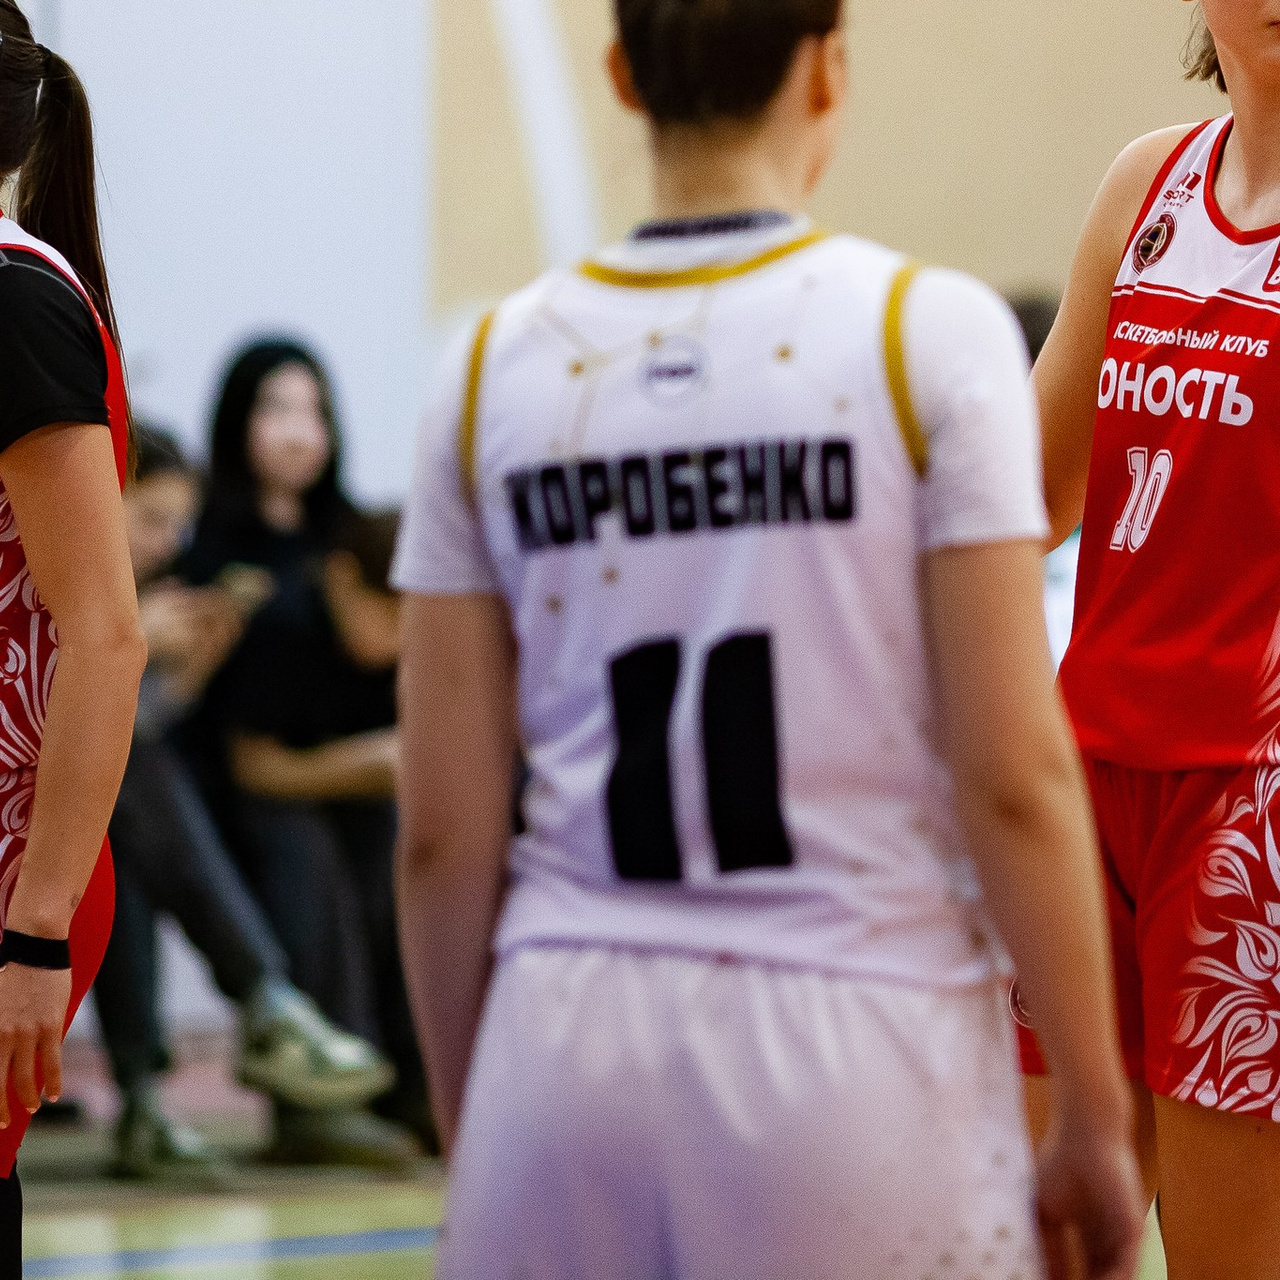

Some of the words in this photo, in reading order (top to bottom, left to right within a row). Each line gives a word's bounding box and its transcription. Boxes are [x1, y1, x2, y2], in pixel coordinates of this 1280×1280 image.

[1220, 334, 1270, 358] КЛУБ
[1109, 446, 1174, 554] 10
[606, 629, 795, 883] 11
